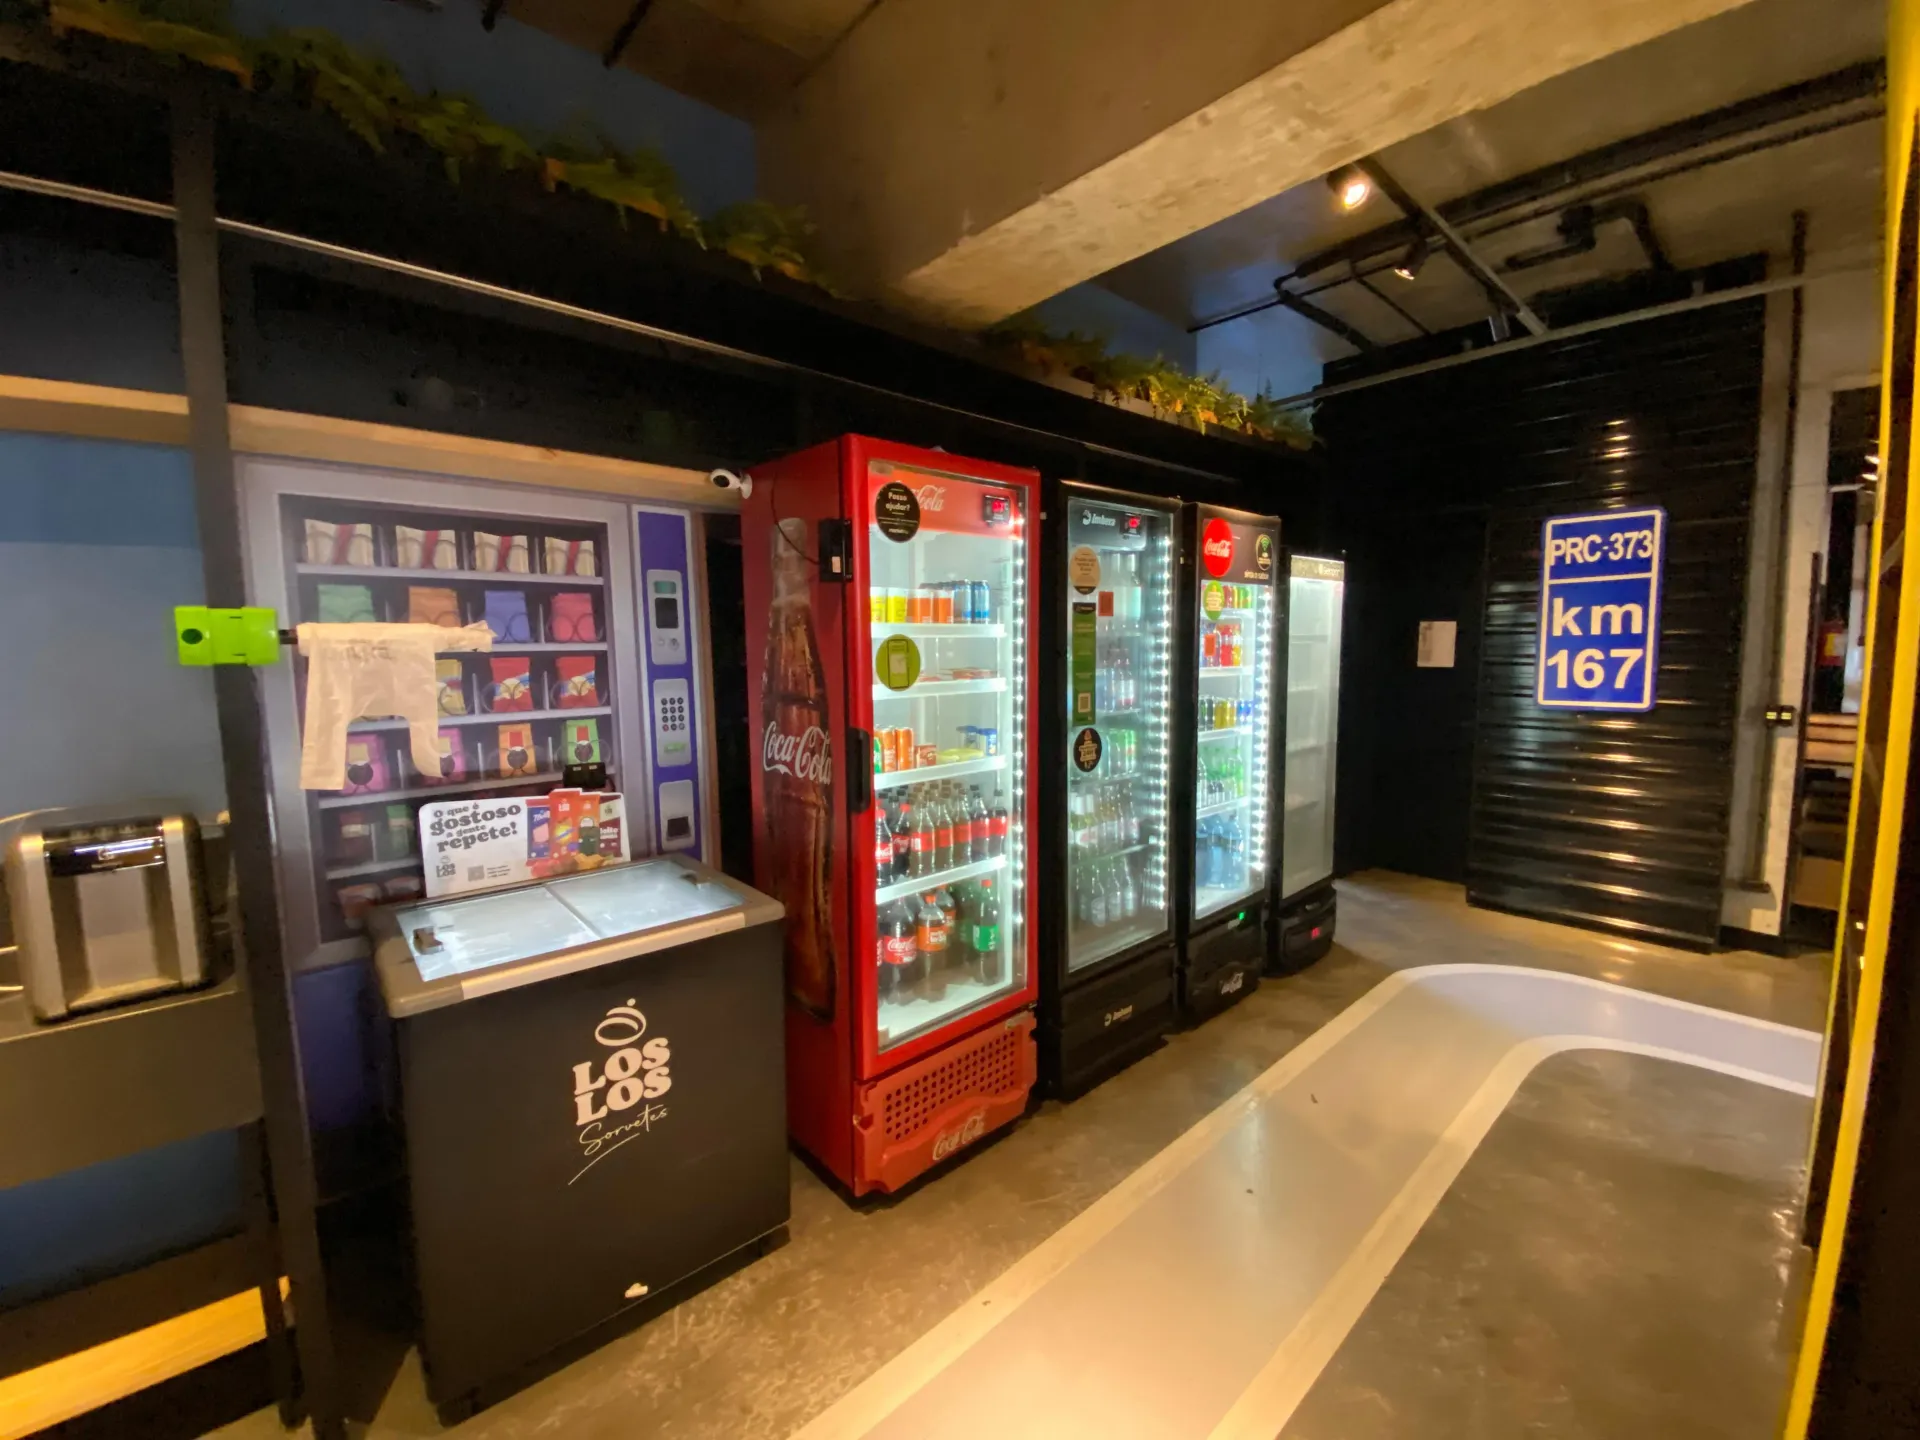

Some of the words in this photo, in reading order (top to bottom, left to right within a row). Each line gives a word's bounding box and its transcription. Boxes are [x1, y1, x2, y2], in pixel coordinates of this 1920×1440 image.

[885, 502, 910, 511] ajudar?
[888, 491, 907, 501] Posso
[1550, 529, 1654, 566] PRC-373
[1553, 597, 1643, 636] km
[1547, 648, 1644, 689] 167
[763, 721, 831, 785] Coca-Cola
[429, 804, 522, 837] gostoso
[446, 806, 469, 816] que
[472, 802, 479, 810] é
[437, 821, 518, 853] repete!
[456, 825, 486, 837] gente
[572, 1037, 670, 1095] LOS
[574, 1066, 672, 1126] LOS
[579, 1104, 668, 1156] Sorvetes
